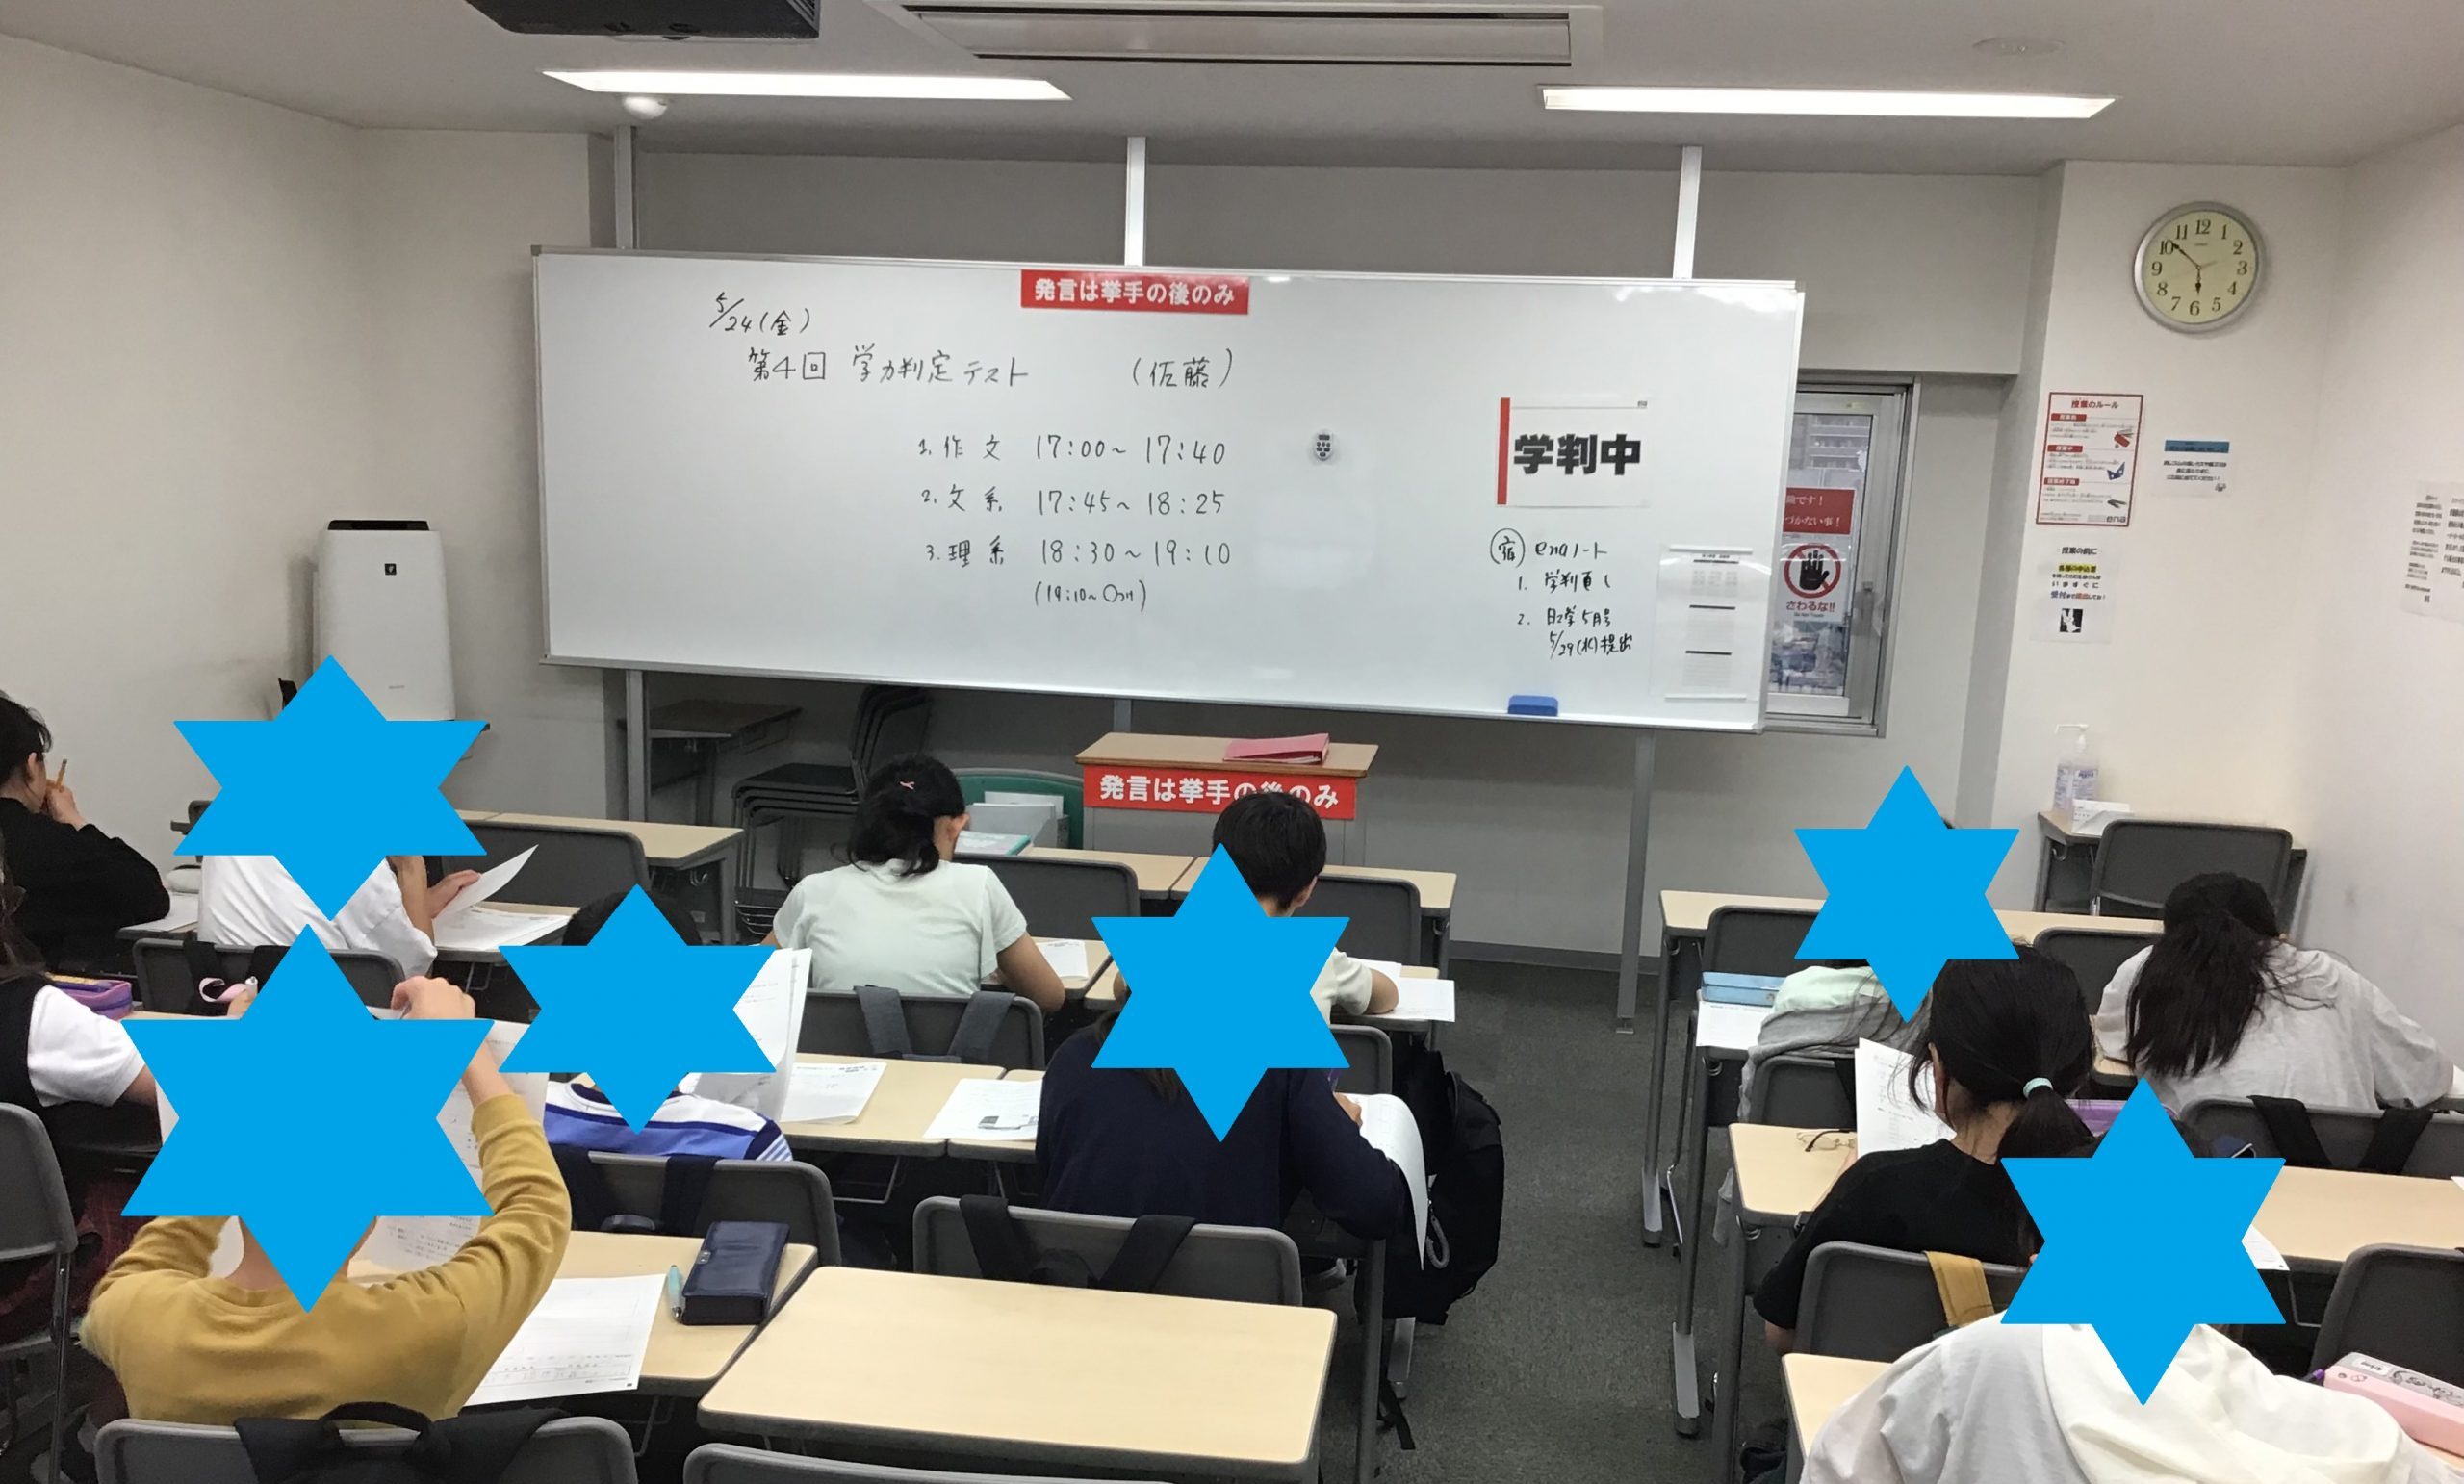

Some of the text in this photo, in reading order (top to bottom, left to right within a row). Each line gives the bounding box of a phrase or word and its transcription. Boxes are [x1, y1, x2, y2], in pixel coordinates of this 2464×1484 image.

[2175, 224, 2188, 240] 11
[2194, 219, 2211, 235] 12
[2221, 224, 2227, 240] 1
[2159, 240, 2174, 255] 10
[2233, 240, 2243, 255] 2
[2151, 261, 2162, 276] 9
[2237, 261, 2247, 275] 3
[1035, 278, 1235, 306] 発言は挙手の後のみ
[2157, 282, 2168, 296] 8
[2228, 281, 2237, 295] 4
[2171, 296, 2181, 311] 7
[2189, 300, 2200, 316] 6
[2212, 297, 2220, 311] 5
[749, 347, 826, 382] 第4回
[1133, 348, 1232, 389] (佐藤)
[1146, 435, 1225, 464] 17:40
[1514, 433, 1641, 475] 学判中
[1148, 490, 1225, 515] 18:25
[1155, 539, 1230, 566] 19:10
